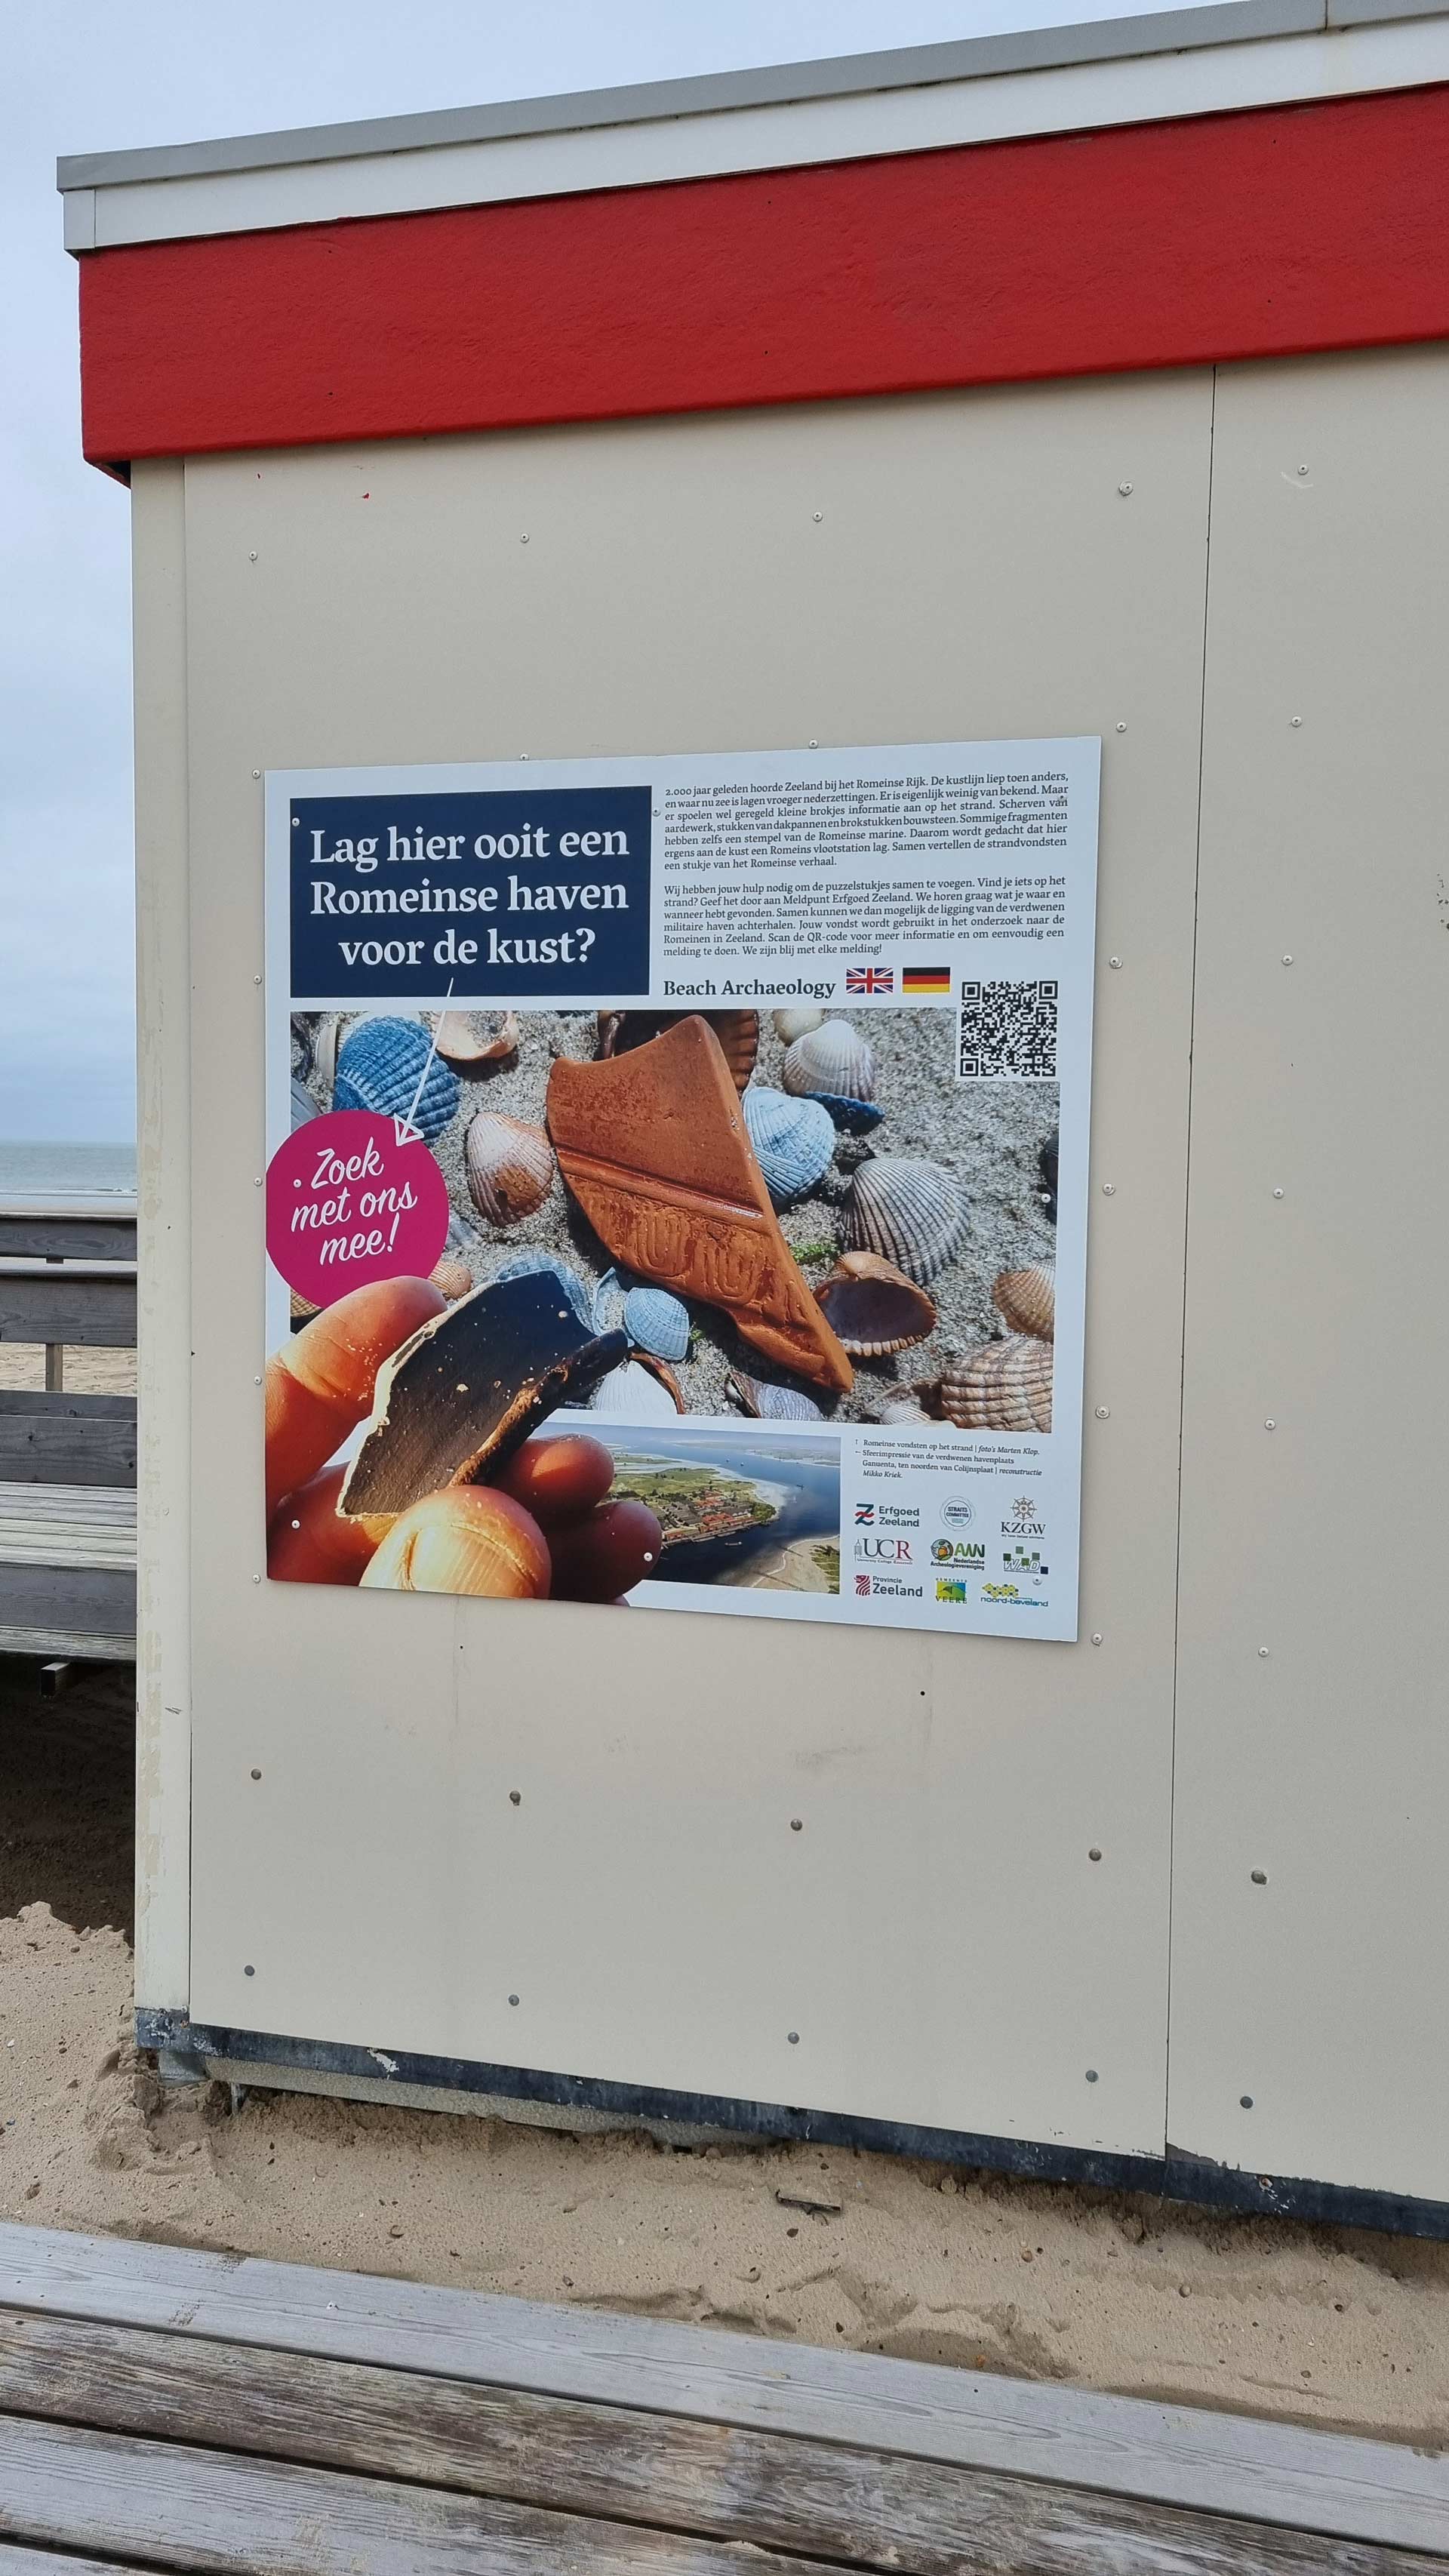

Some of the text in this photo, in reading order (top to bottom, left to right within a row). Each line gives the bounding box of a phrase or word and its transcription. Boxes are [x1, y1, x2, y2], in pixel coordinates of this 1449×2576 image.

[694, 786, 711, 796] jaar
[712, 783, 748, 796] geleden
[750, 782, 783, 792] hoorde
[785, 780, 823, 791] Zeeland
[825, 780, 836, 791] bij
[838, 779, 854, 789] het
[857, 778, 903, 788] Romeinse
[906, 776, 928, 789] Rijk.
[931, 776, 944, 785] De
[946, 774, 984, 786] kustlijn
[986, 774, 1004, 785] liep
[1031, 771, 1068, 781] anders,
[677, 810, 712, 822] spoelen
[715, 809, 731, 818] wel
[734, 807, 774, 820] geregeld
[777, 807, 806, 816] kleine
[810, 805, 844, 817] brokjes
[848, 803, 900, 814] informatie
[924, 804, 937, 814] op
[940, 802, 956, 811] het
[960, 800, 995, 810] strand.
[998, 799, 1045, 808] Scherven
[664, 836, 698, 845] hebben
[701, 834, 722, 844] zelfs
[744, 832, 780, 845] stempel
[804, 831, 815, 841] de
[818, 830, 866, 840] Romeinse
[869, 829, 906, 839] marine.
[909, 828, 949, 837] Daarom
[952, 826, 981, 836] wordt
[984, 825, 1023, 838] gedacht
[1026, 825, 1043, 833] dat
[1046, 824, 1067, 833] hier
[309, 823, 629, 873] Lag hier ooit een
[664, 850, 694, 860] ergens
[715, 846, 726, 856] de
[728, 846, 749, 855] kust
[770, 845, 811, 854] Romeins
[813, 843, 870, 853] vlootstation
[872, 842, 889, 854] lag.
[892, 842, 925, 851] Samen
[928, 839, 971, 849] vertellen
[973, 839, 985, 848] de
[987, 836, 1066, 848] strandvondsten
[682, 860, 711, 871] stukje
[733, 858, 748, 868] het
[750, 857, 796, 867] Romeinse
[798, 856, 836, 866] verhaal.
[310, 875, 629, 914] Romeinse haven
[664, 885, 680, 897] Wij
[682, 884, 715, 894] hebben
[718, 884, 740, 895] jouw
[743, 883, 764, 894] hulp
[766, 882, 792, 894] nodig
[812, 881, 823, 891] de
[826, 880, 890, 893] puzzelstukjes
[937, 880, 974, 890] voegen.
[977, 876, 1001, 886] Vind
[1004, 877, 1012, 889] je
[1014, 876, 1032, 885] iets
[1034, 879, 1047, 888] op
[1049, 875, 1065, 885] het
[663, 922, 703, 931] militaire
[706, 921, 734, 930] haven
[737, 919, 795, 930] achterhalen.
[799, 919, 823, 929] Jouw
[826, 918, 857, 928] vondst
[861, 918, 890, 927] wordt
[892, 917, 934, 929] gebruikt
[938, 917, 948, 926] in
[951, 916, 968, 925] het
[971, 915, 1023, 925] onderzoek
[1052, 914, 1064, 924] de
[663, 934, 710, 943] Romeinen
[713, 934, 722, 942] in
[725, 932, 764, 942] Zeeland.
[768, 932, 790, 941] Scan
[793, 932, 804, 941] de
[807, 931, 848, 942] QR-code
[903, 930, 955, 939] informatie
[992, 928, 1043, 940] eenvoudig
[338, 928, 595, 965] voor de kust?
[663, 978, 835, 999] Beach Archaeology
[310, 1137, 384, 1190] Zoek
[291, 1181, 418, 1232] met ons
[320, 1213, 399, 1265] mee!
[862, 1449, 910, 1459] Sfeerimpressie
[974, 1455, 1014, 1464] havenplaats
[863, 1439, 895, 1447] Romeinse
[977, 1445, 995, 1453] foto's
[1022, 1448, 1039, 1456] Klop.
[862, 1460, 896, 1468] Ganuenta,
[953, 1464, 993, 1473] Colijnsplaat
[878, 1517, 919, 1527] Zeeland
[879, 1507, 919, 1516] Erfgoed
[1001, 1522, 1046, 1534] KZGW
[863, 1538, 912, 1559] UCR
[872, 1583, 922, 1597] Zeeland
[935, 1596, 967, 1604] VEERE
[980, 1597, 1048, 1607] noord-beveland
